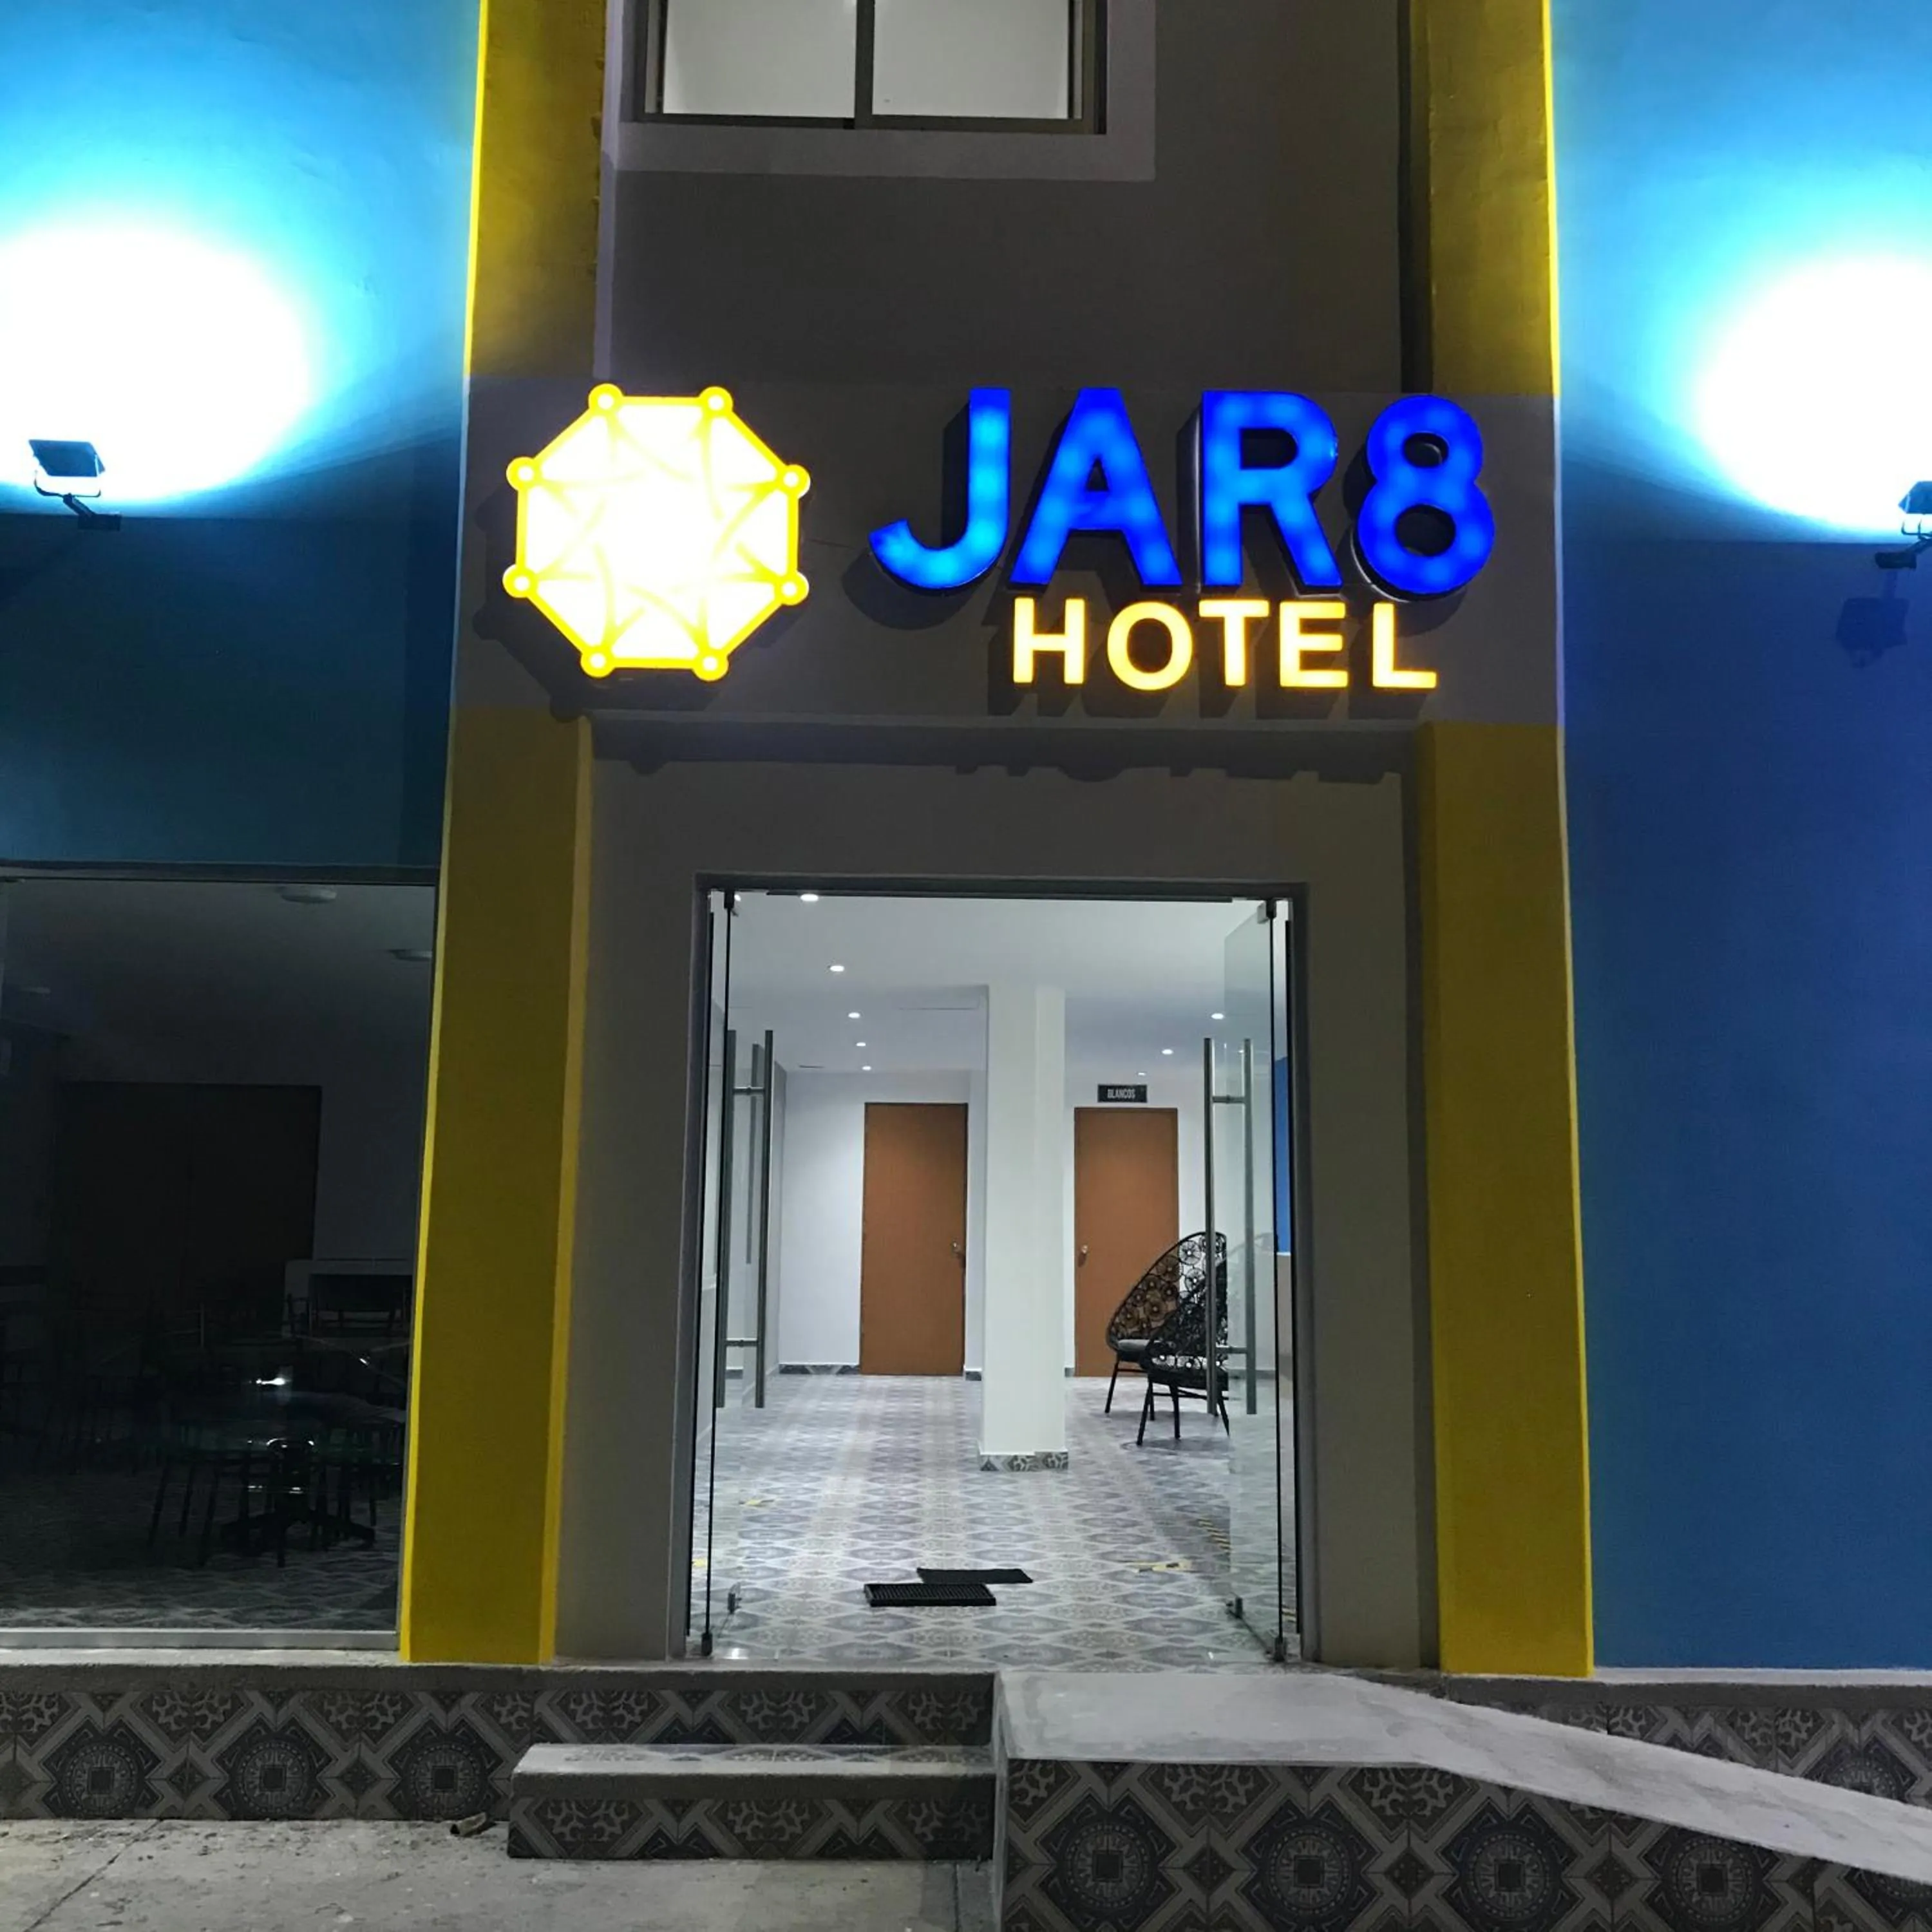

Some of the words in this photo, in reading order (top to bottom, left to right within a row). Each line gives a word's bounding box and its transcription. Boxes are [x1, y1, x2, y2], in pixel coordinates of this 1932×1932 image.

[869, 388, 1495, 595] JAR8
[1013, 598, 1437, 691] HOTEL
[1107, 1088, 1136, 1099] BLANCOS
